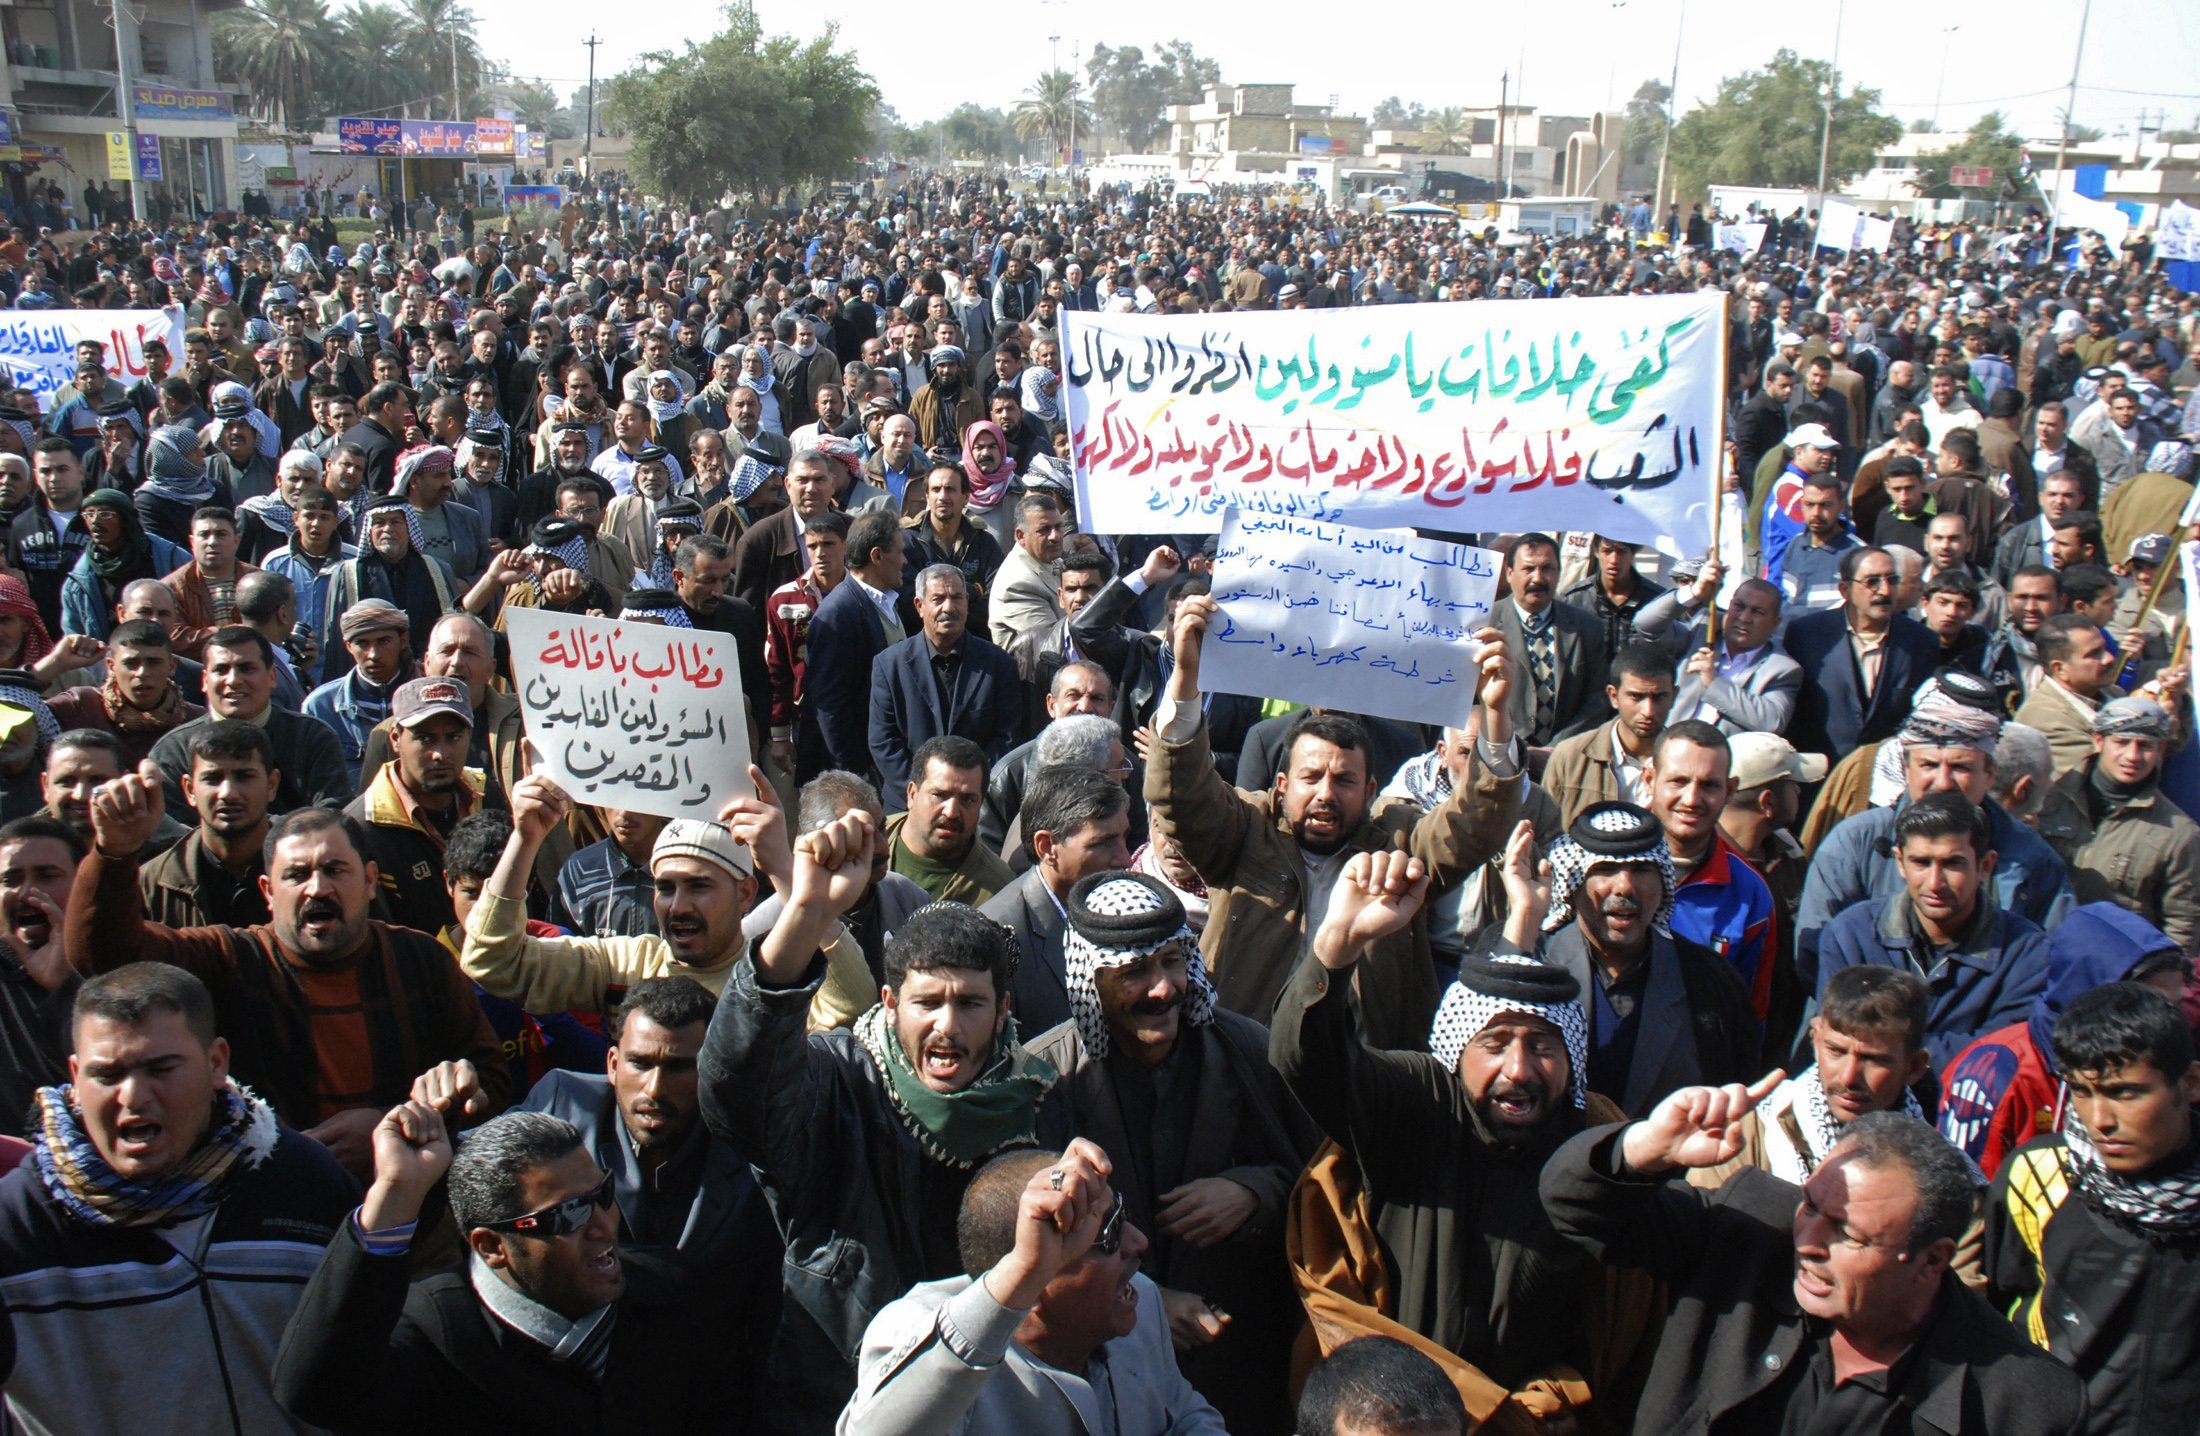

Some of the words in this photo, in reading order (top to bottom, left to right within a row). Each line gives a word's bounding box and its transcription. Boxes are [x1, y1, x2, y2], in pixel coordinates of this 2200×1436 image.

[1382, 541, 1404, 554] من
[1409, 545, 1494, 578] نطالب
[632, 641, 724, 694] نطالب
